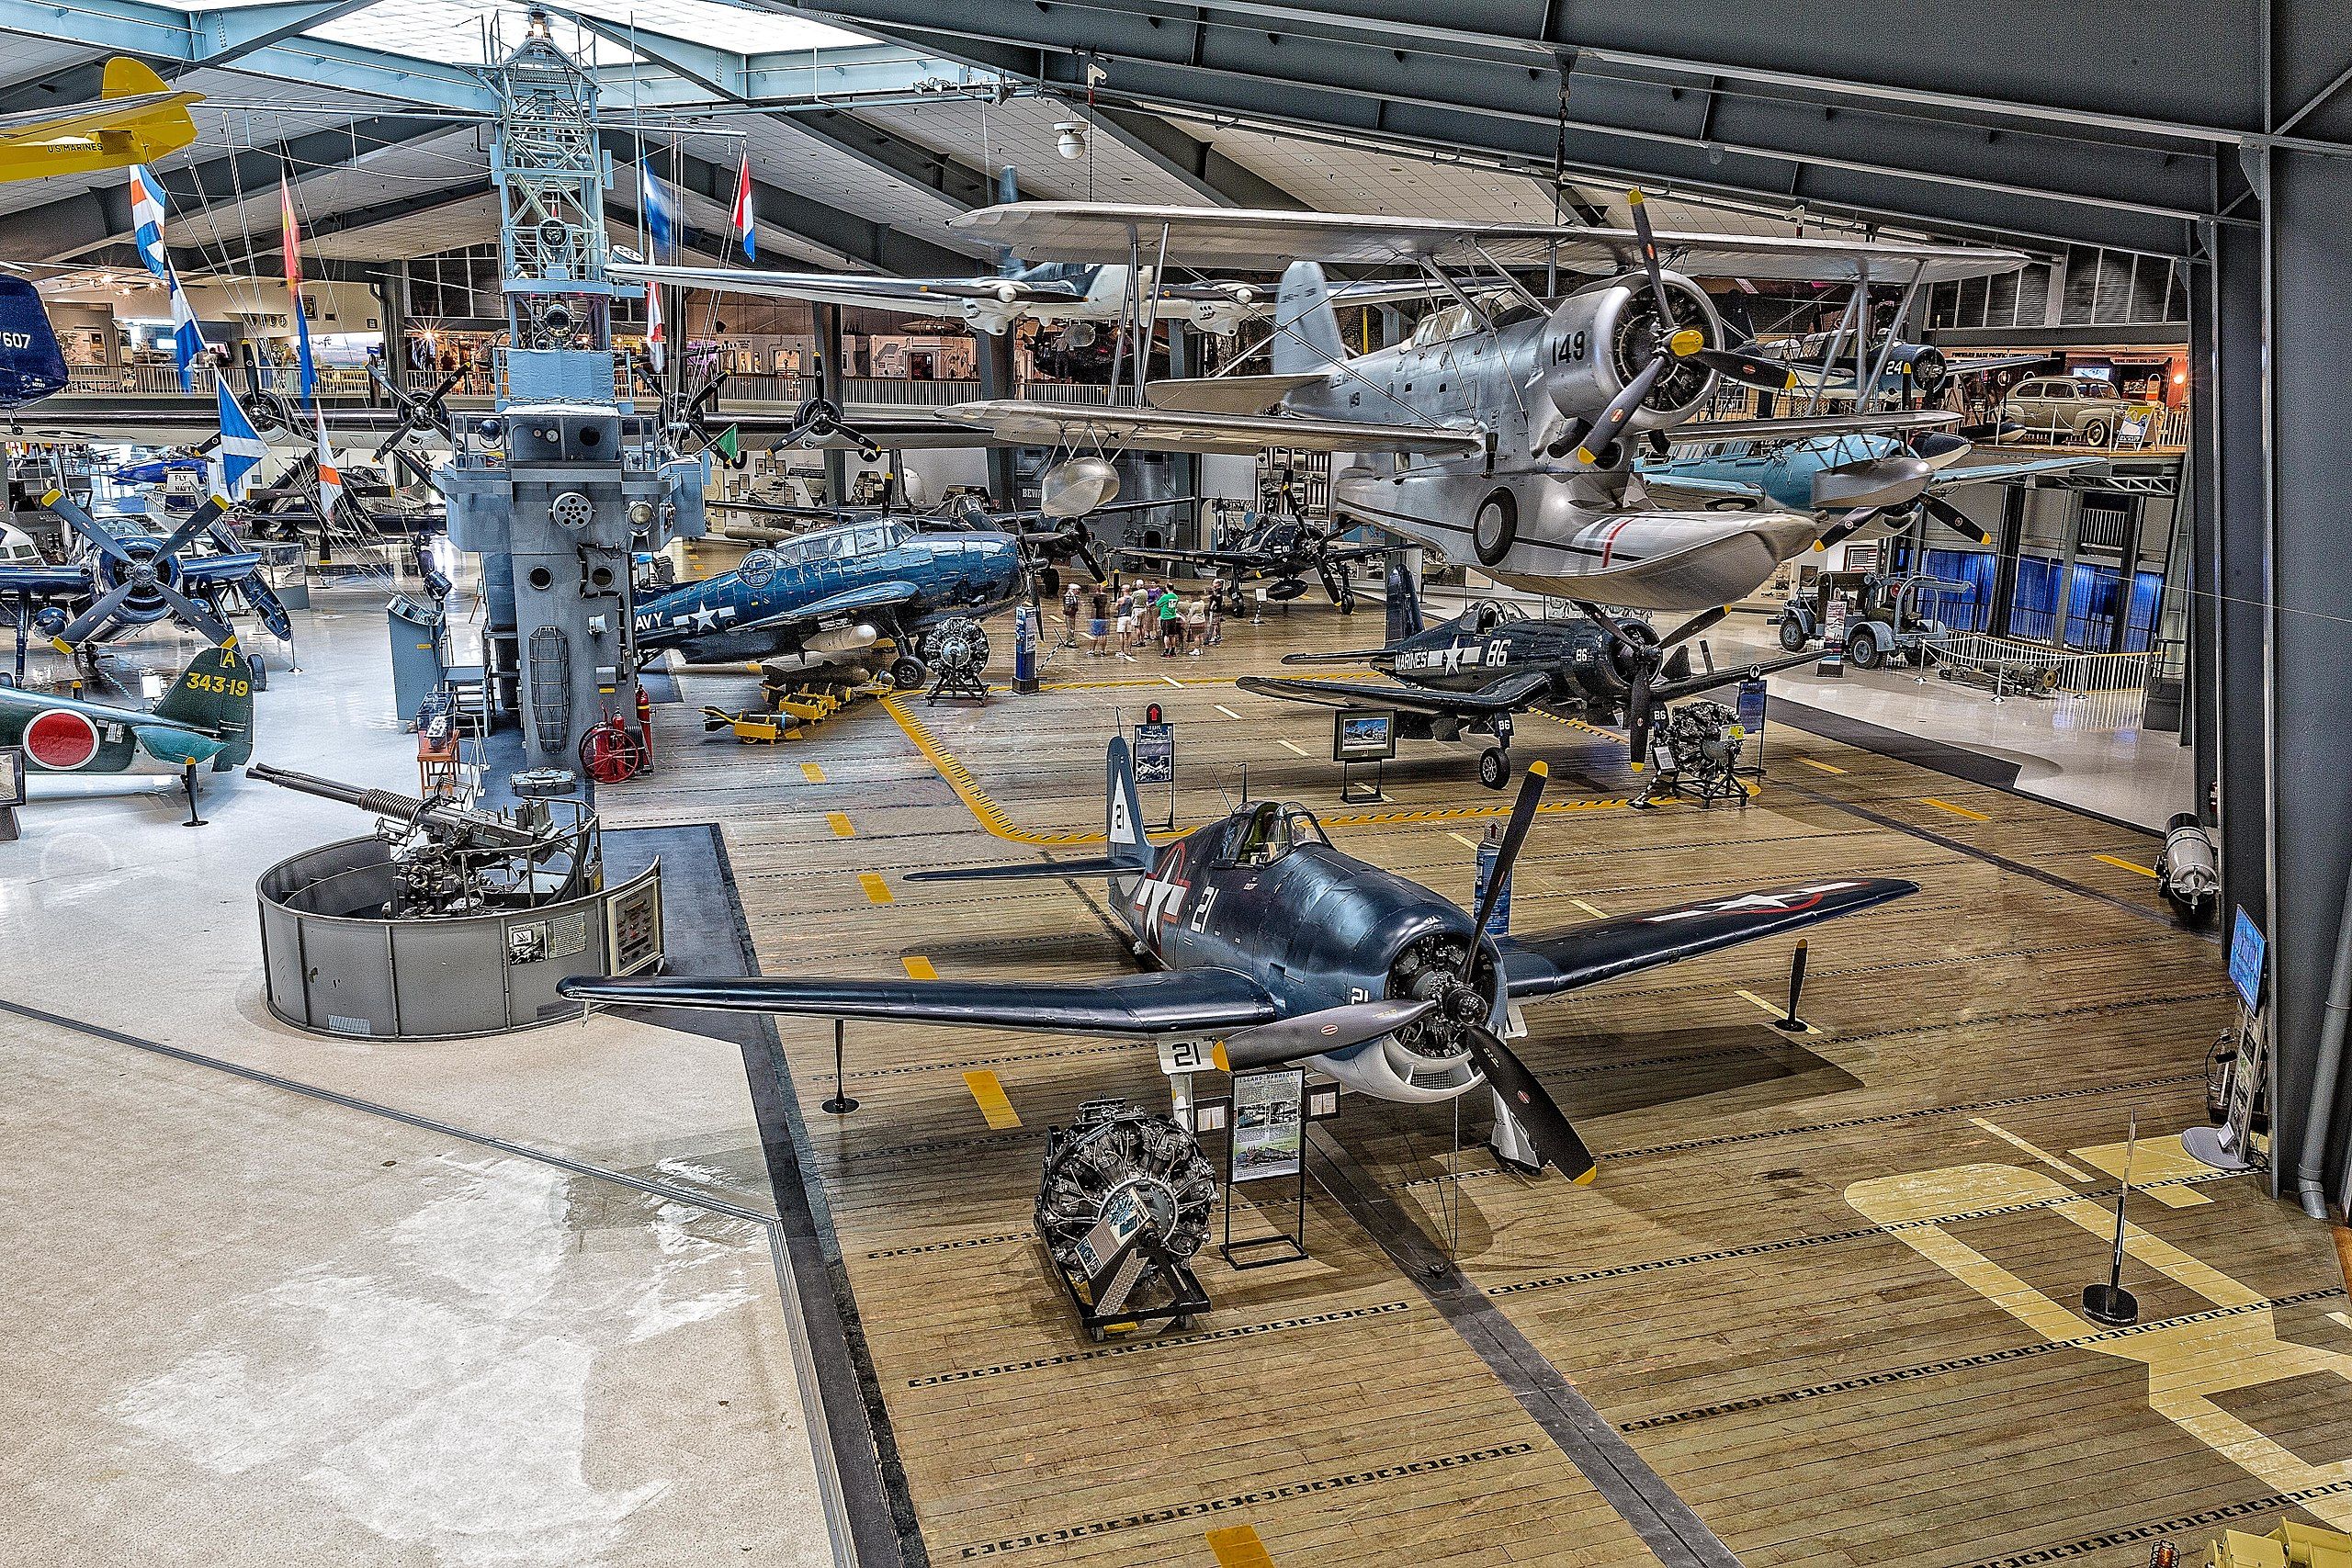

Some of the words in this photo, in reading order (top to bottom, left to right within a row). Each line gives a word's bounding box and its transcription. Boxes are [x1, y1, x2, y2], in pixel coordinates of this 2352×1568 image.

[63, 143, 104, 152] MARINES
[0, 332, 31, 349] 607
[1552, 330, 1586, 367] 149
[1885, 360, 1904, 376] 24
[634, 611, 663, 632] AVY
[221, 650, 236, 668] A
[1395, 649, 1428, 671] MARINES
[1486, 638, 1511, 667] 86
[1576, 648, 1588, 662] 86
[186, 671, 249, 697] 343-19
[1654, 710, 1667, 721] 86
[1498, 719, 1510, 731] 86
[1115, 804, 1125, 830] 21
[1190, 886, 1220, 934] 21
[1351, 987, 1370, 1005] 21
[1171, 1041, 1202, 1067] 21
